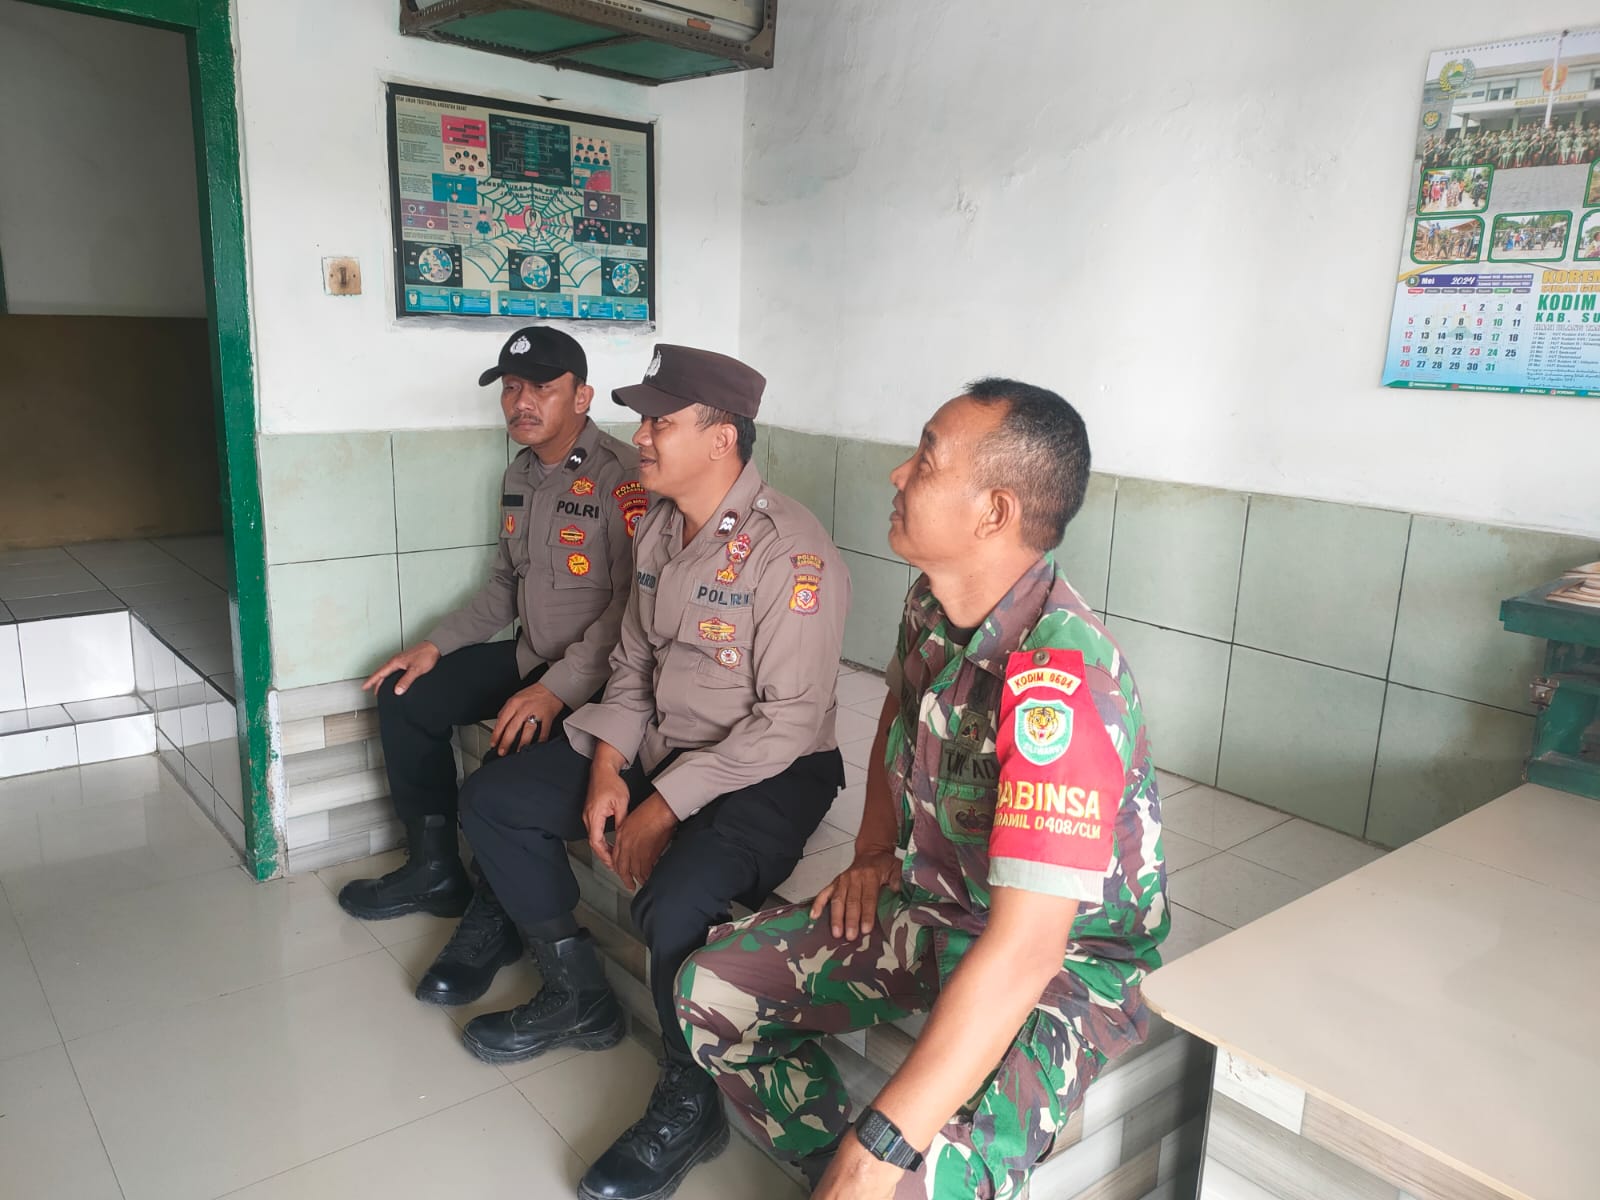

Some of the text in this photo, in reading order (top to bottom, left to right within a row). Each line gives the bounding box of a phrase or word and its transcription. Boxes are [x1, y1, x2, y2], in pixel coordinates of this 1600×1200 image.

[1421, 277, 1435, 285] Mei
[1450, 276, 1476, 285] 2024
[1538, 294, 1597, 310] KODIM
[1476, 318, 1482, 326] 9
[1513, 319, 1520, 327] 11
[1536, 312, 1571, 323] KAB.
[1404, 331, 1412, 339] 12
[1437, 332, 1446, 340] 14
[1417, 346, 1427, 354] 20
[1451, 347, 1462, 355] 22
[1469, 348, 1480, 356] 23
[1505, 349, 1516, 357] 25
[1449, 362, 1460, 370] 29
[1467, 363, 1478, 371] 30
[557, 500, 599, 519] POLRI
[1014, 672, 1074, 688] KODIM 0604
[993, 812, 1101, 839] RAMIL 0408/CLM
